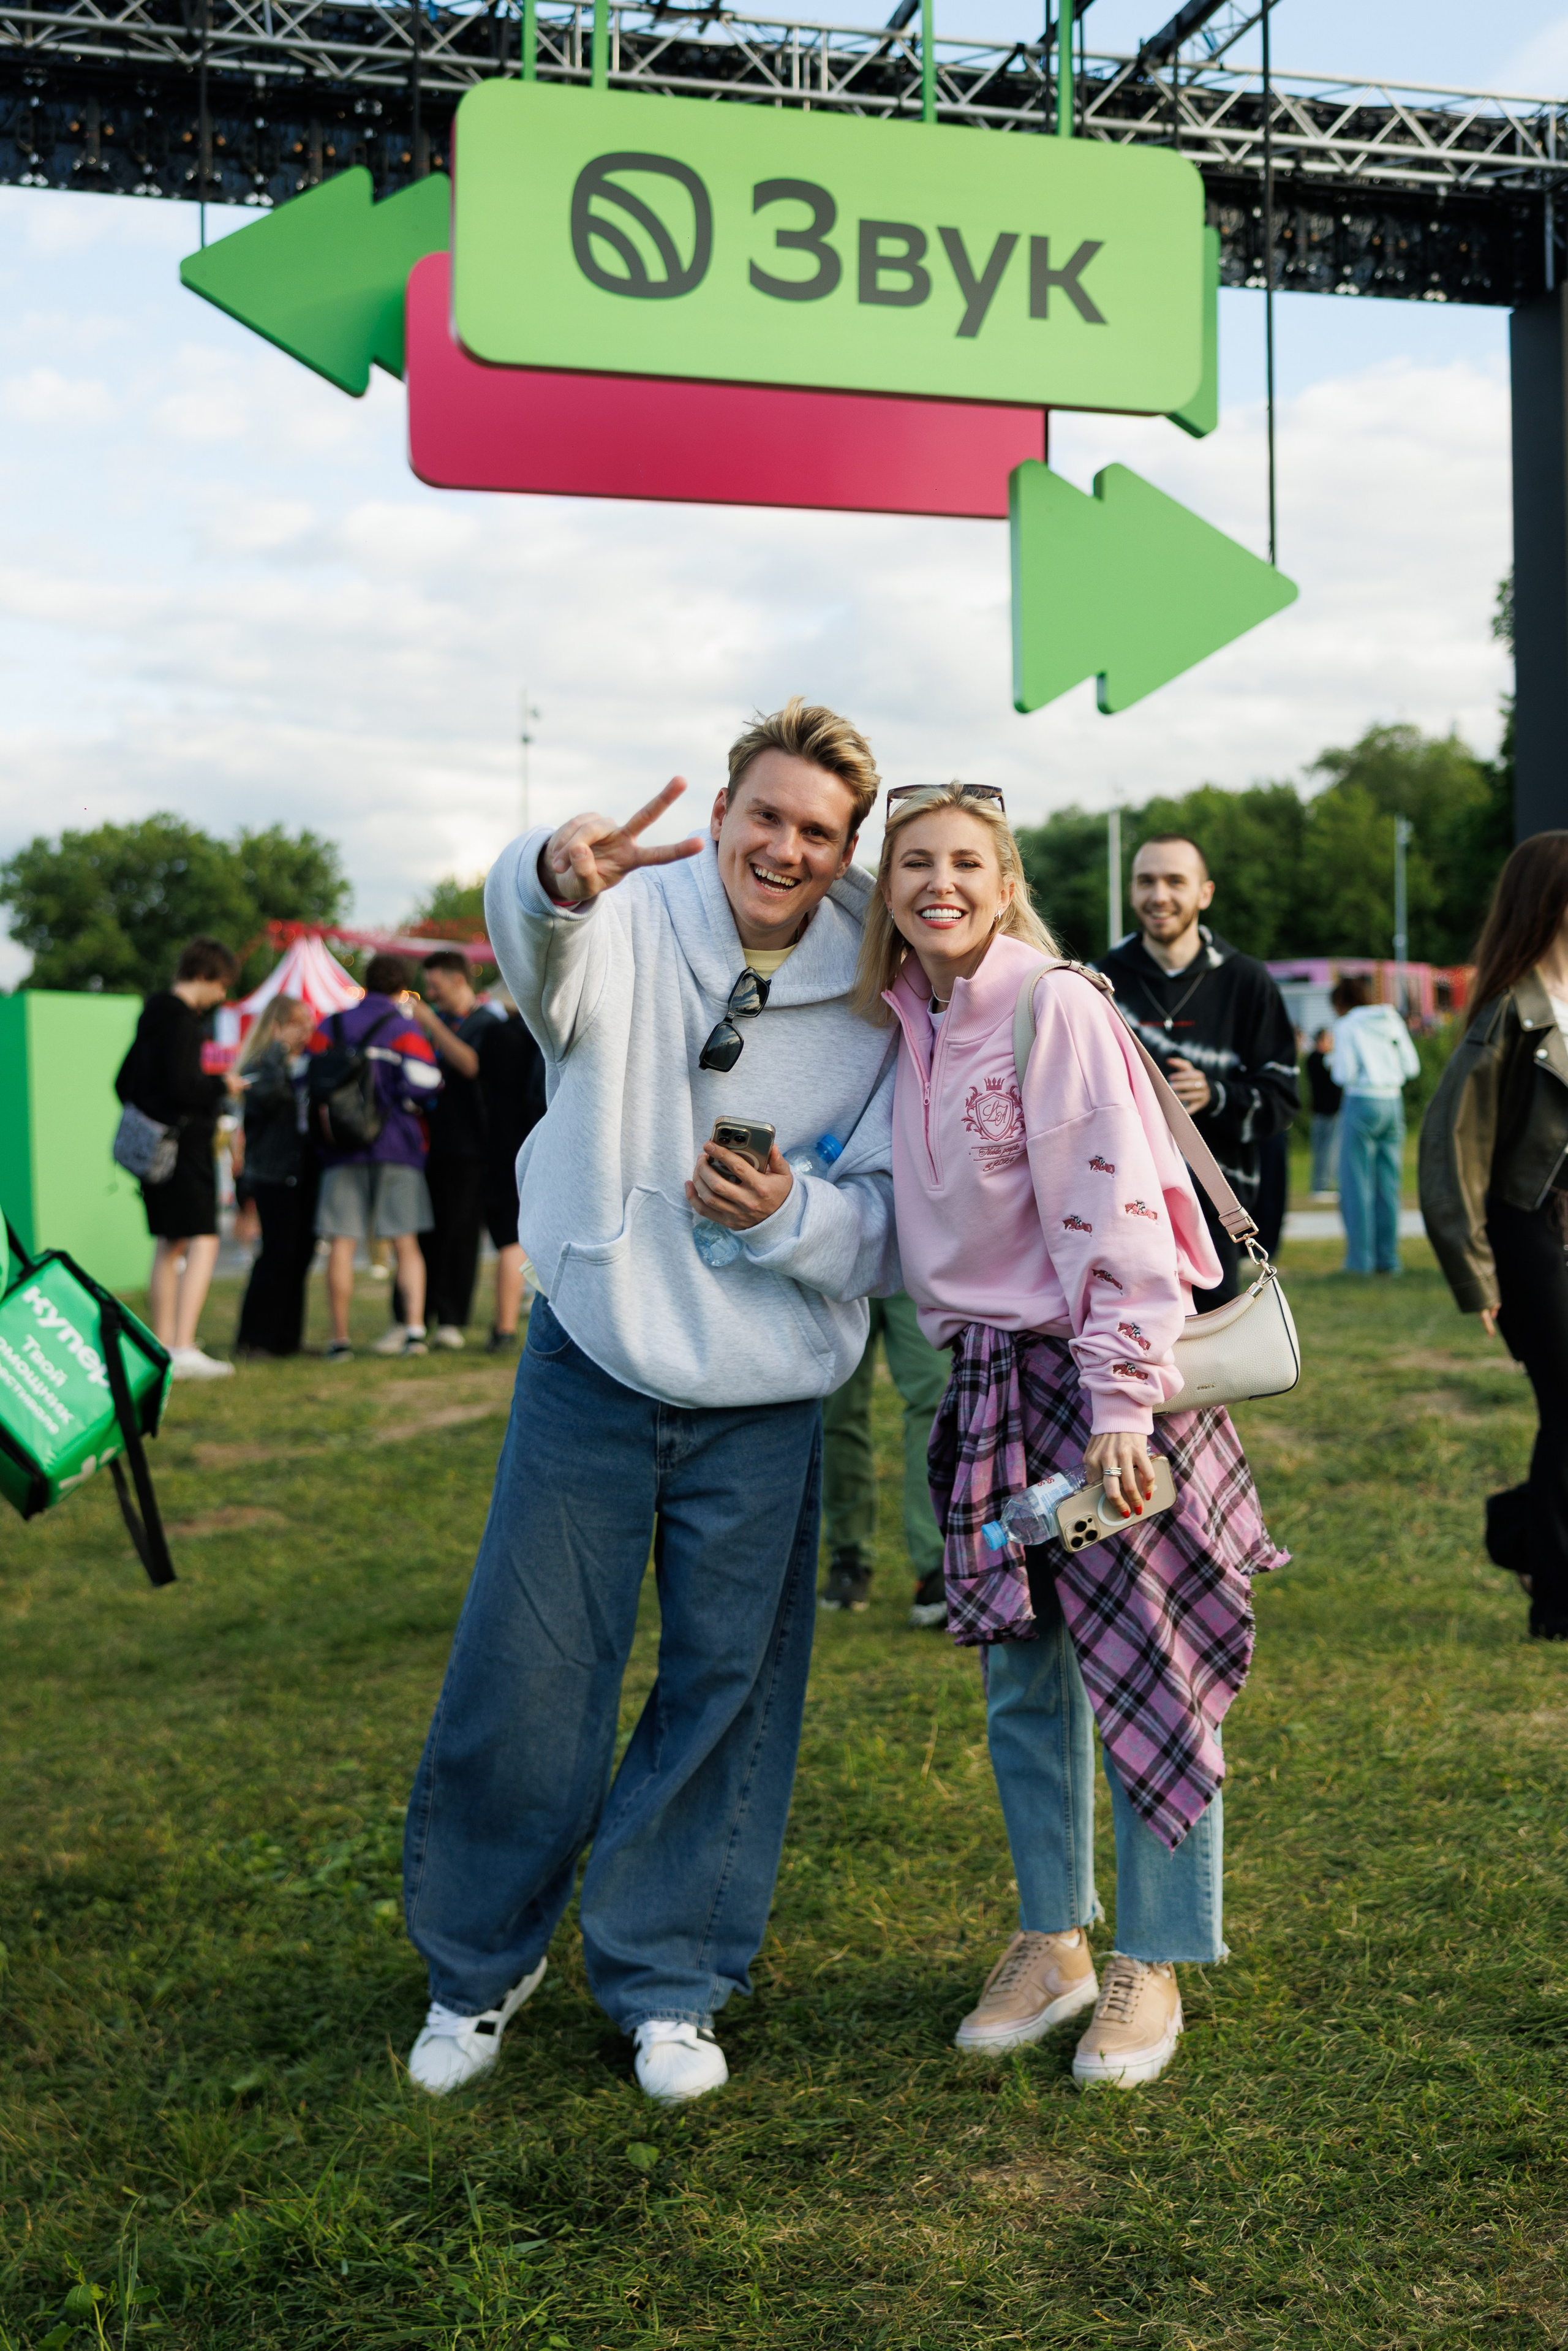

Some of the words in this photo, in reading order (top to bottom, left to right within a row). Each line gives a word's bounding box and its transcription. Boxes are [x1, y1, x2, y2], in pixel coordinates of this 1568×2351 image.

[748, 177, 1109, 339] Звук
[0, 1336, 74, 1425] омощник
[22, 1334, 67, 1387] Твой
